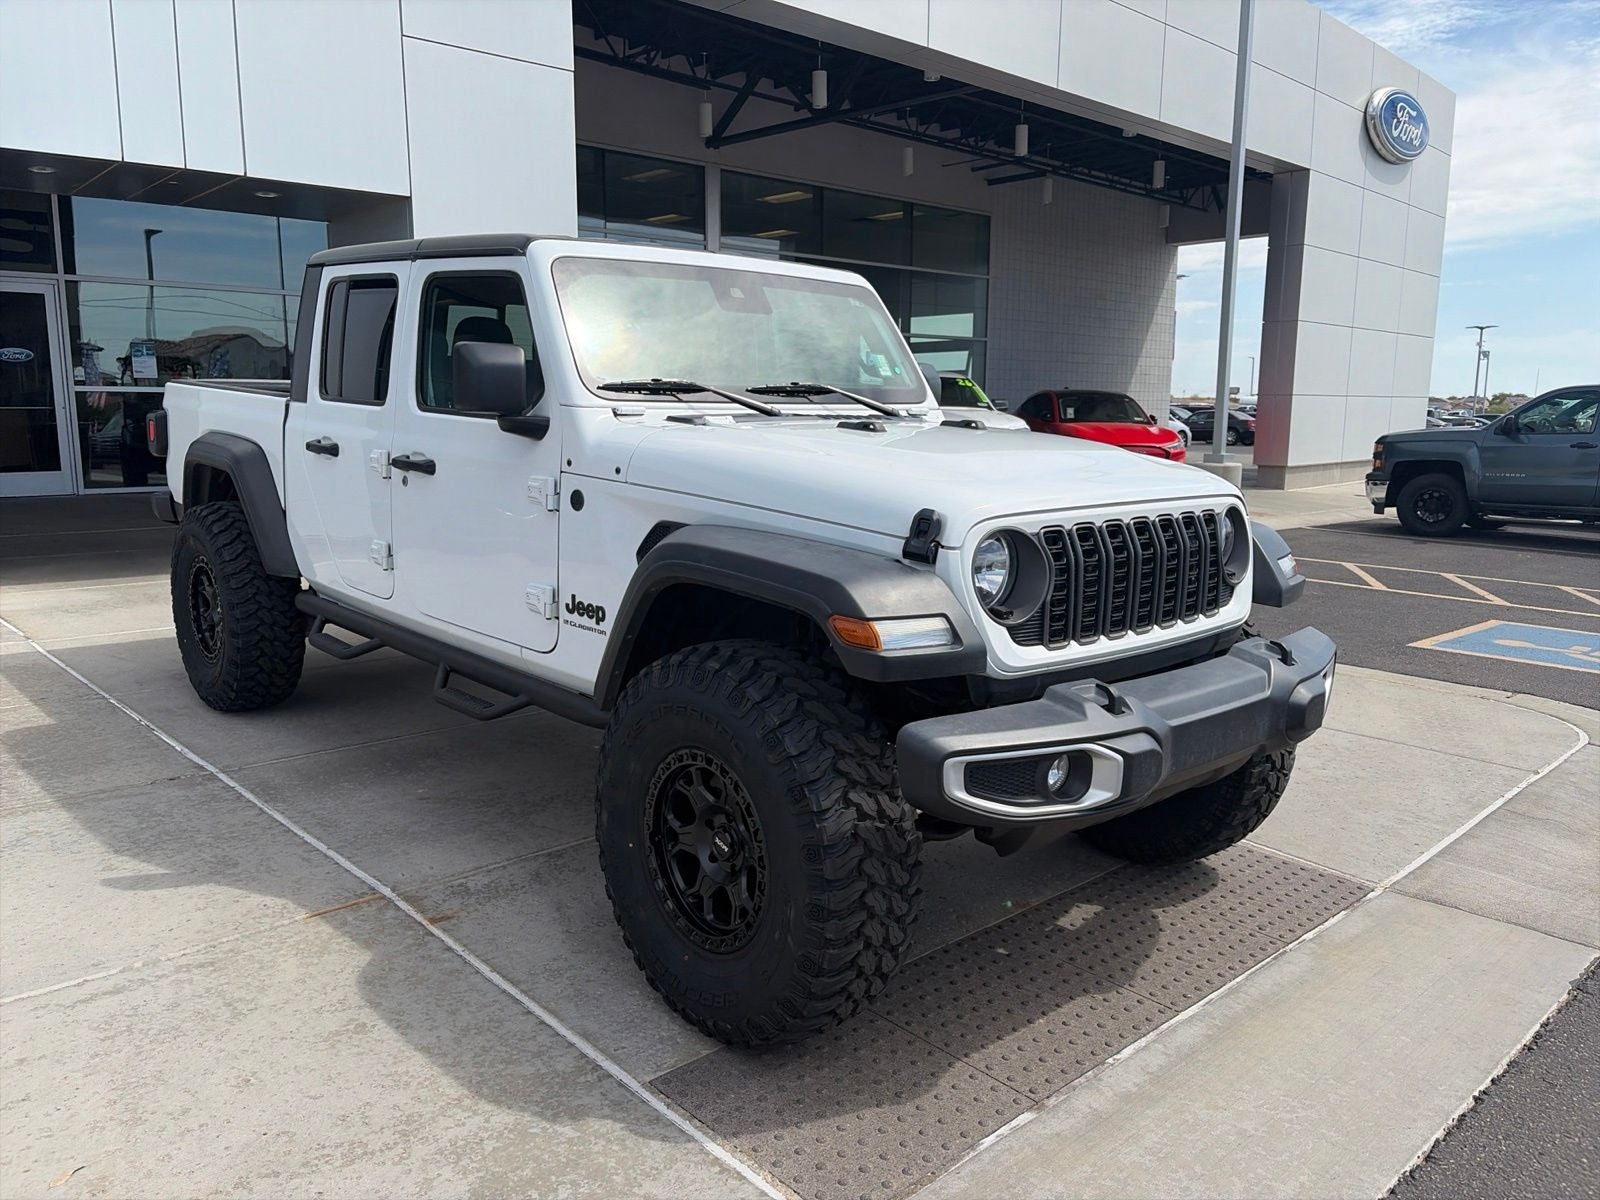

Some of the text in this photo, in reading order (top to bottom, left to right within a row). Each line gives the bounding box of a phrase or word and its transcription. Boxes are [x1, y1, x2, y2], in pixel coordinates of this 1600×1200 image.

[1391, 102, 1424, 147] Ford
[1, 350, 26, 359] Ford
[565, 593, 606, 626] Jeep
[569, 620, 607, 636] GLADIATOR
